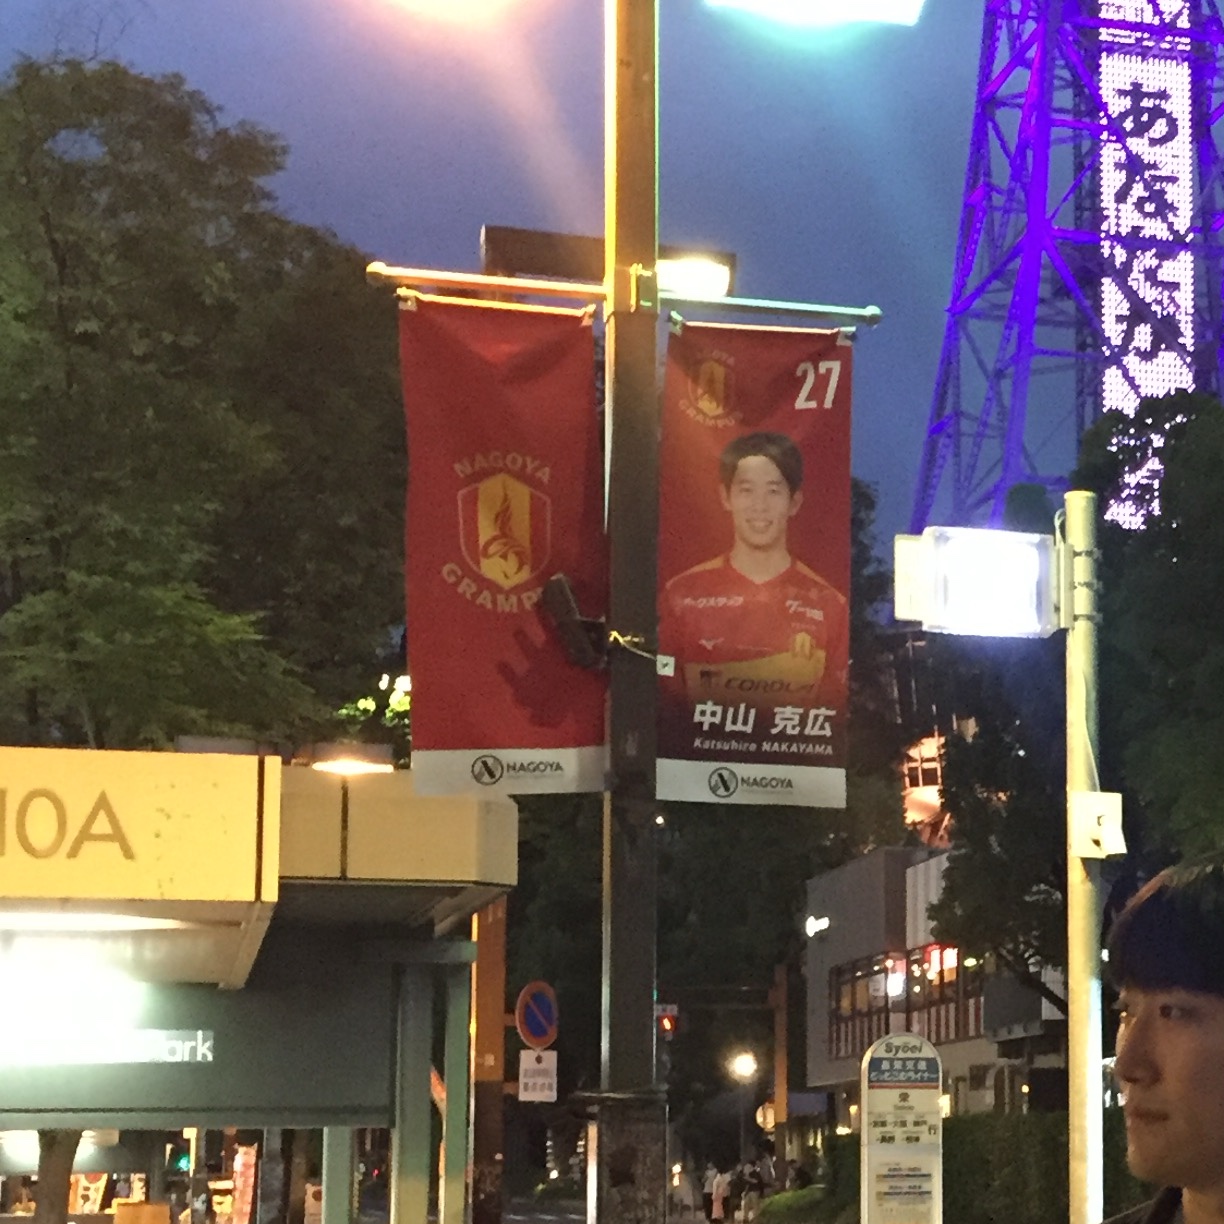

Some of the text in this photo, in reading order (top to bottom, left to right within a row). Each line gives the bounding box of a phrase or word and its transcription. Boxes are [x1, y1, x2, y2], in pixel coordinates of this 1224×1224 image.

[794, 360, 841, 410] 27
[453, 451, 550, 484] NAGOYA
[441, 562, 543, 613] GRAMP
[693, 699, 837, 737] 中山 克広
[762, 740, 833, 755] NAKAYAMA
[506, 760, 563, 773] NAGOYA
[740, 776, 794, 789] NAGOYA
[162, 1029, 214, 1062] ark
